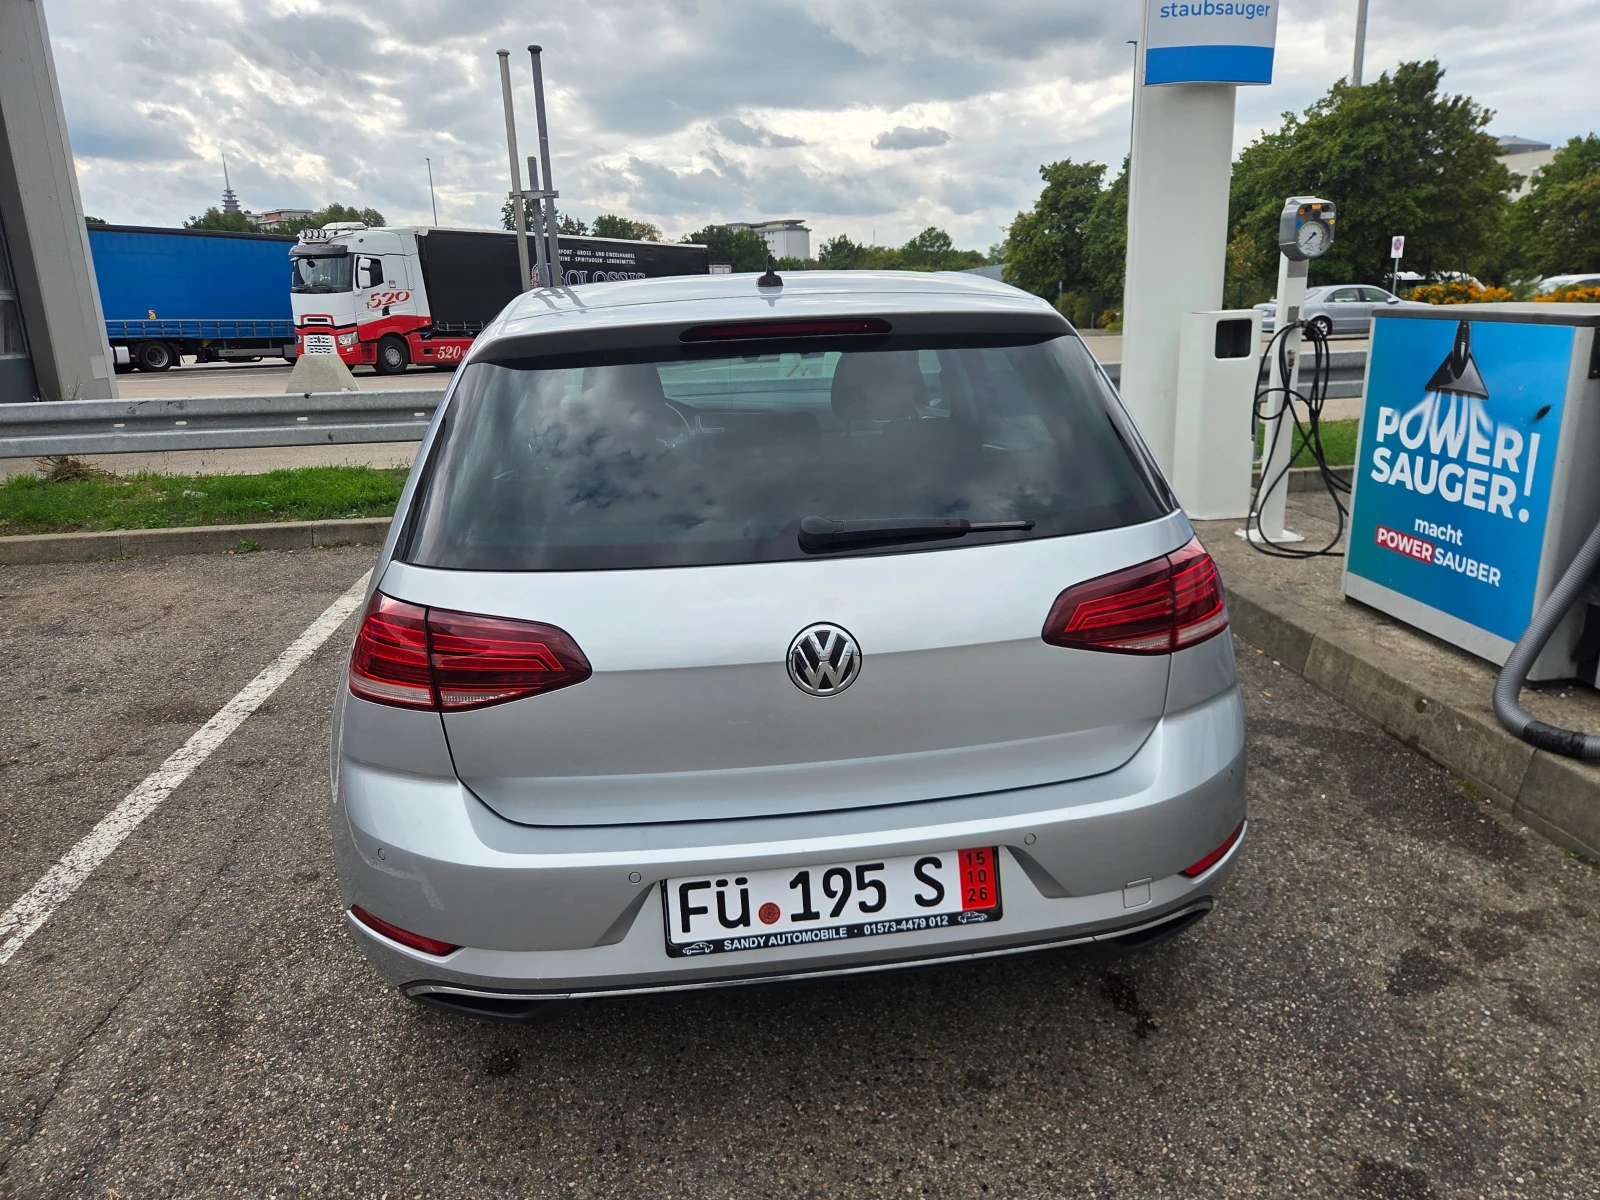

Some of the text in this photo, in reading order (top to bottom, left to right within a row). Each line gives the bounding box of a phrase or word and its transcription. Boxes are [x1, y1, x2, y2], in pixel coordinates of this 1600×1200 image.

[1160, 0, 1271, 20] staubsauger
[437, 345, 461, 360] 520
[1414, 518, 1464, 546] macht
[1377, 527, 1502, 587] POWER SAUBER
[966, 851, 986, 866] 15
[967, 869, 987, 884] 10
[789, 862, 887, 922] 195
[913, 856, 945, 907] S
[967, 886, 988, 902] 26
[723, 915, 949, 951] SANDY AUTOMOBILE 01573-4479 012
